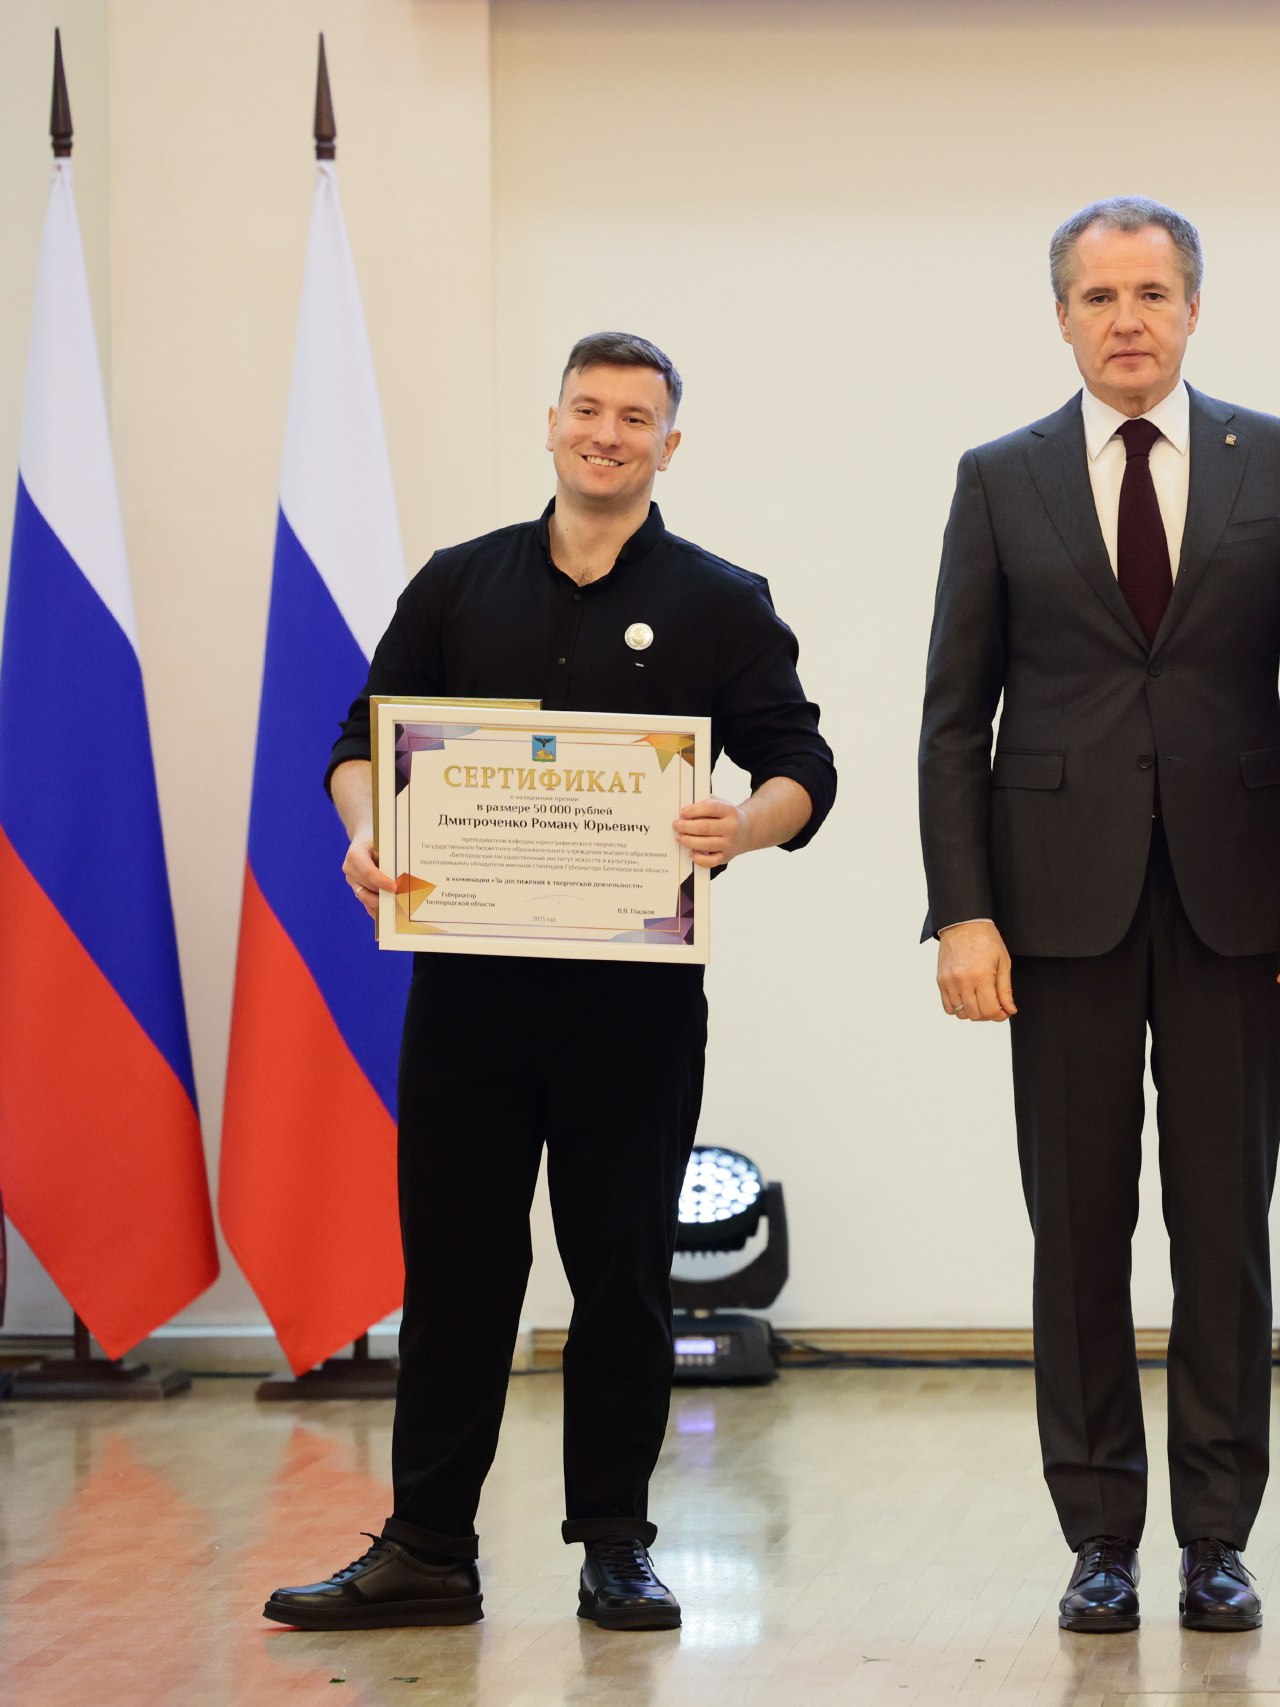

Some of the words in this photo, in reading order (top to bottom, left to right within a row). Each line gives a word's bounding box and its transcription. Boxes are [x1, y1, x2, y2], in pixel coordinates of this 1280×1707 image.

[443, 765, 646, 794] СЕРТИФИКАТ
[486, 804, 530, 814] размере
[533, 804, 547, 814] 50
[550, 804, 571, 814] 000
[574, 806, 613, 816] рублей
[438, 814, 527, 829] Дмитроченко
[531, 818, 580, 832] Роману
[583, 819, 650, 835] Юрьевичу
[441, 891, 476, 899] Губернатор
[427, 899, 469, 907] Белгородской
